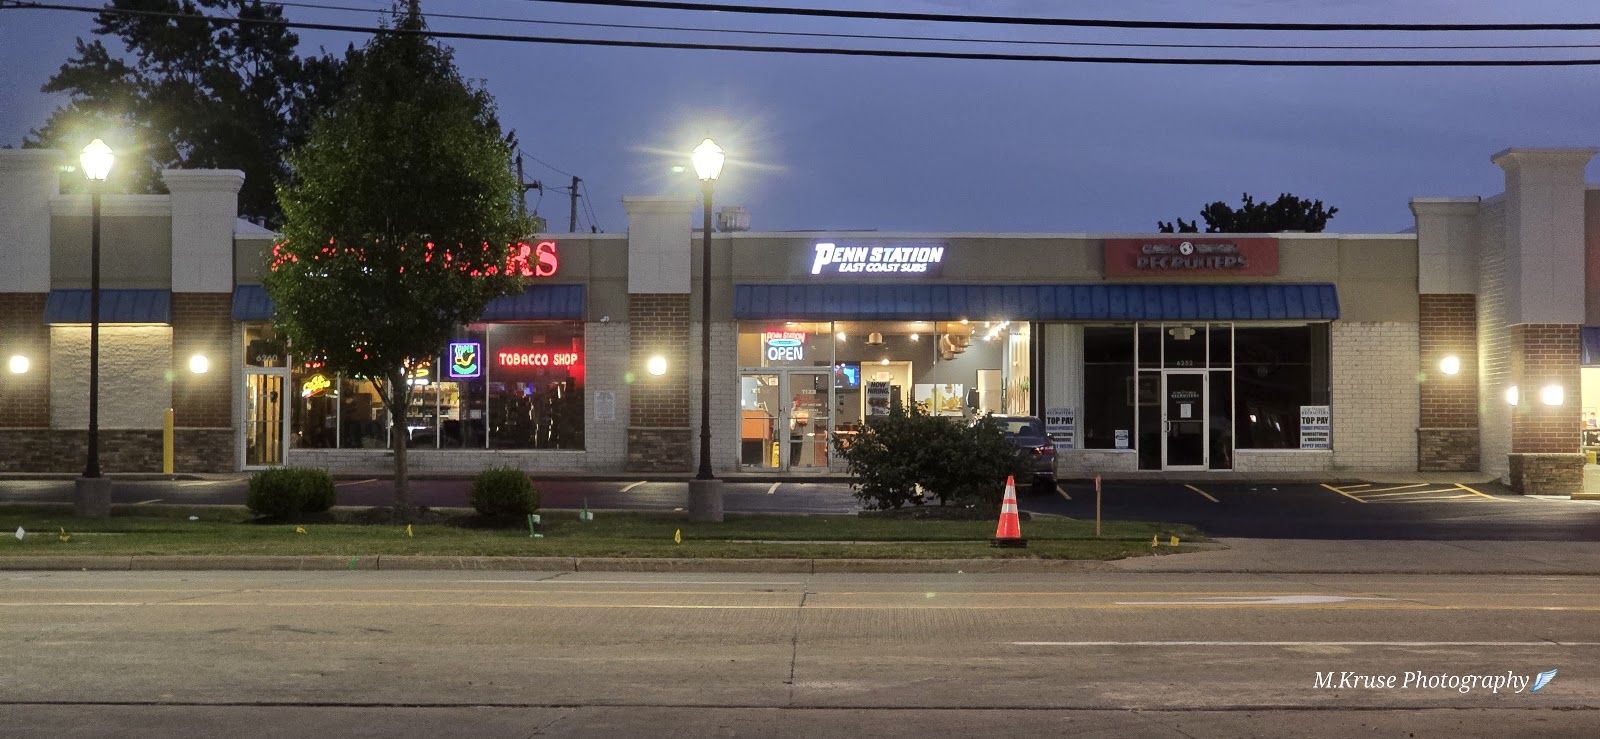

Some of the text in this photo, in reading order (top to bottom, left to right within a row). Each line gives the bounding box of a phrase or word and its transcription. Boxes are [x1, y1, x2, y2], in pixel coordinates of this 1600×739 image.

[812, 243, 944, 274] PENN STATION
[1137, 256, 1249, 269] RECRUITERS
[838, 263, 927, 272] EAST COAST SUBS
[256, 354, 278, 362] 6260
[768, 346, 803, 361] OPEN
[499, 353, 578, 366] TOBACCO SHOP
[1047, 416, 1074, 424] TOP PAY
[1302, 416, 1328, 424] TOP PAY
